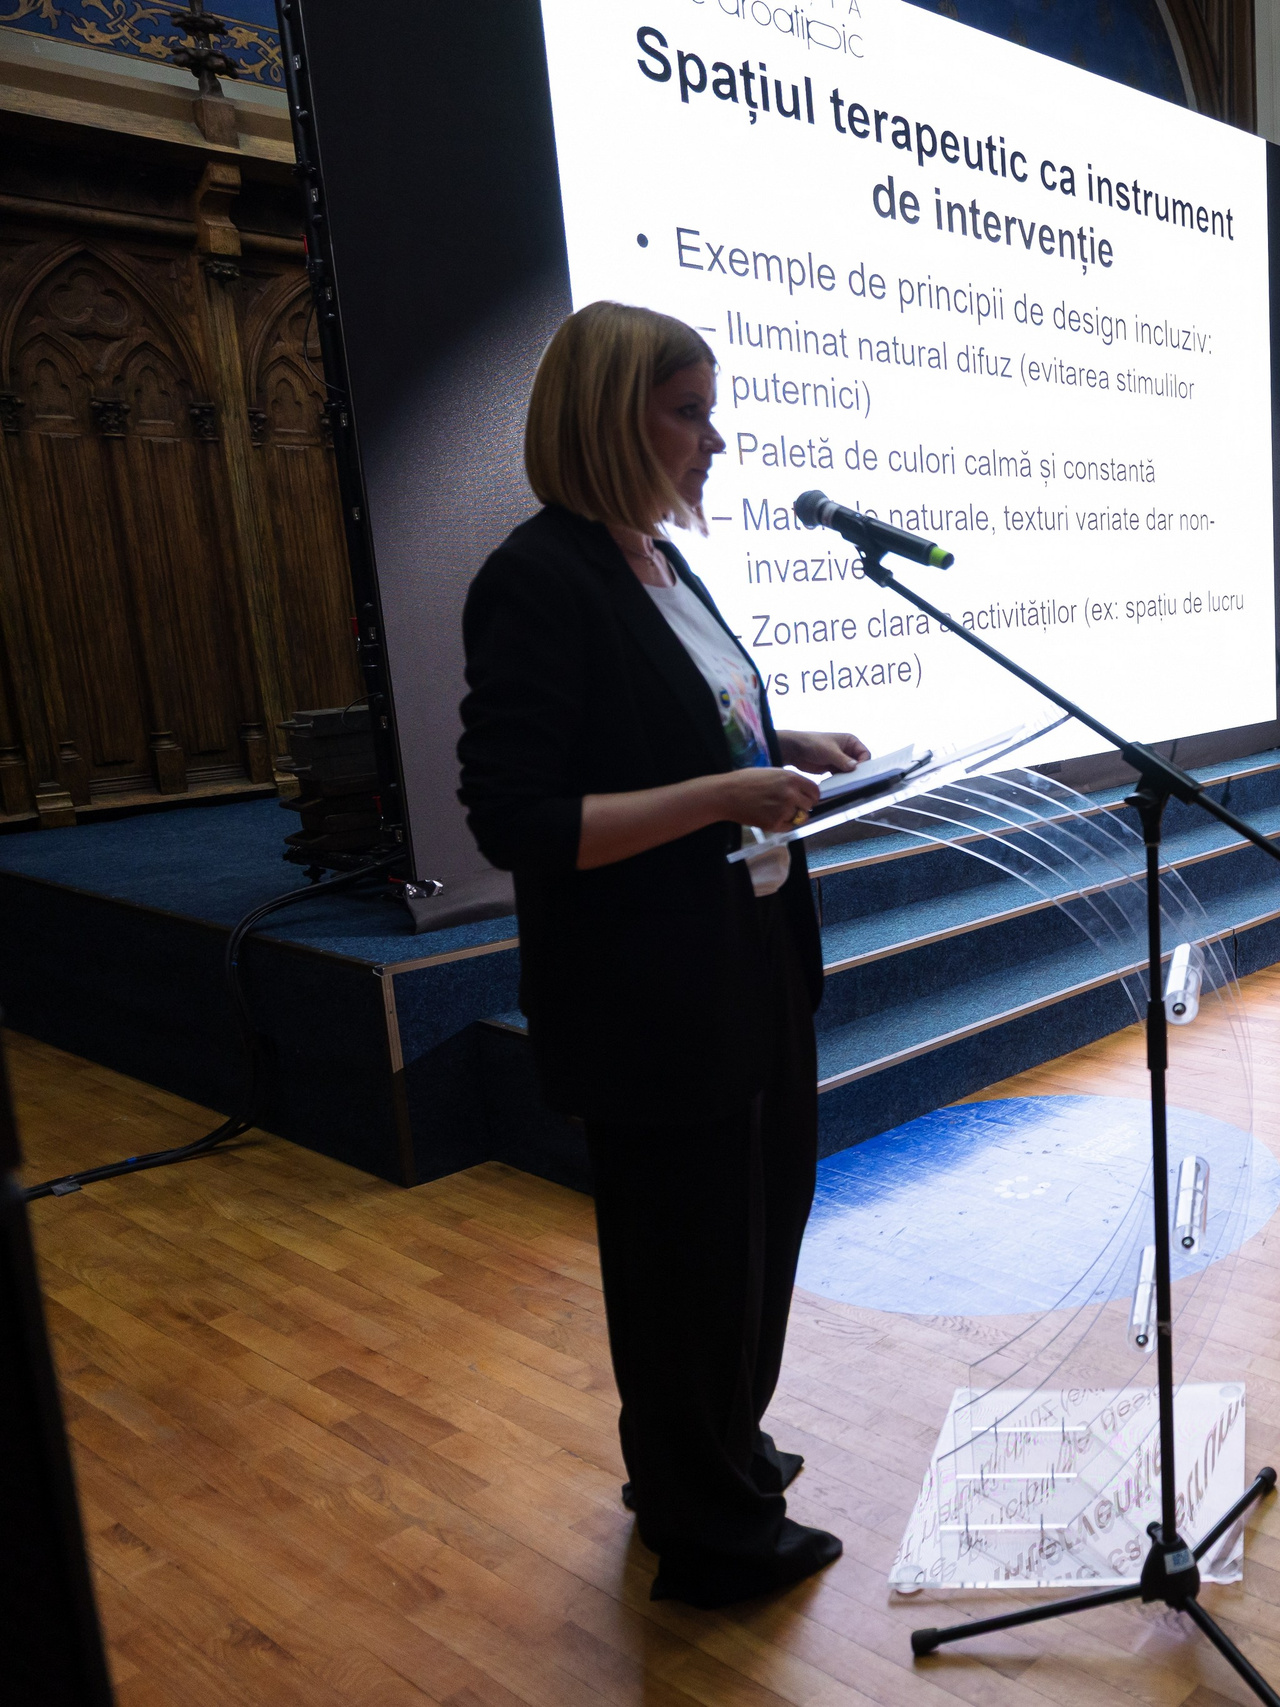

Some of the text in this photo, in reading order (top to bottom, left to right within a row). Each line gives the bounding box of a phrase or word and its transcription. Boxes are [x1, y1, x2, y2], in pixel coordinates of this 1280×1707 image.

[637, 26, 1235, 241] Spațiul terapeutic ca instrument
[873, 175, 1114, 275] de intervenție
[676, 227, 1213, 354] Exemple de principii de design incluziv:
[727, 310, 1195, 400] Iluminat natural difuz (evitarea stimulilor
[732, 373, 871, 419] puternici)
[736, 432, 1156, 487] Paletă de culori calmă și constantă
[889, 503, 995, 536] naturale,
[1004, 506, 1069, 531] texturi
[1076, 507, 1140, 531] variate
[1146, 507, 1173, 531] dar
[1180, 513, 1216, 531] non-
[747, 551, 866, 584] invazive
[752, 614, 857, 648] Zonare
[962, 598, 1077, 633] activităților
[1085, 598, 1119, 628] (ex:
[1126, 594, 1177, 625] spațiu
[1183, 592, 1203, 614] de
[1208, 591, 1244, 613] lucru
[801, 653, 922, 694] relaxare)
